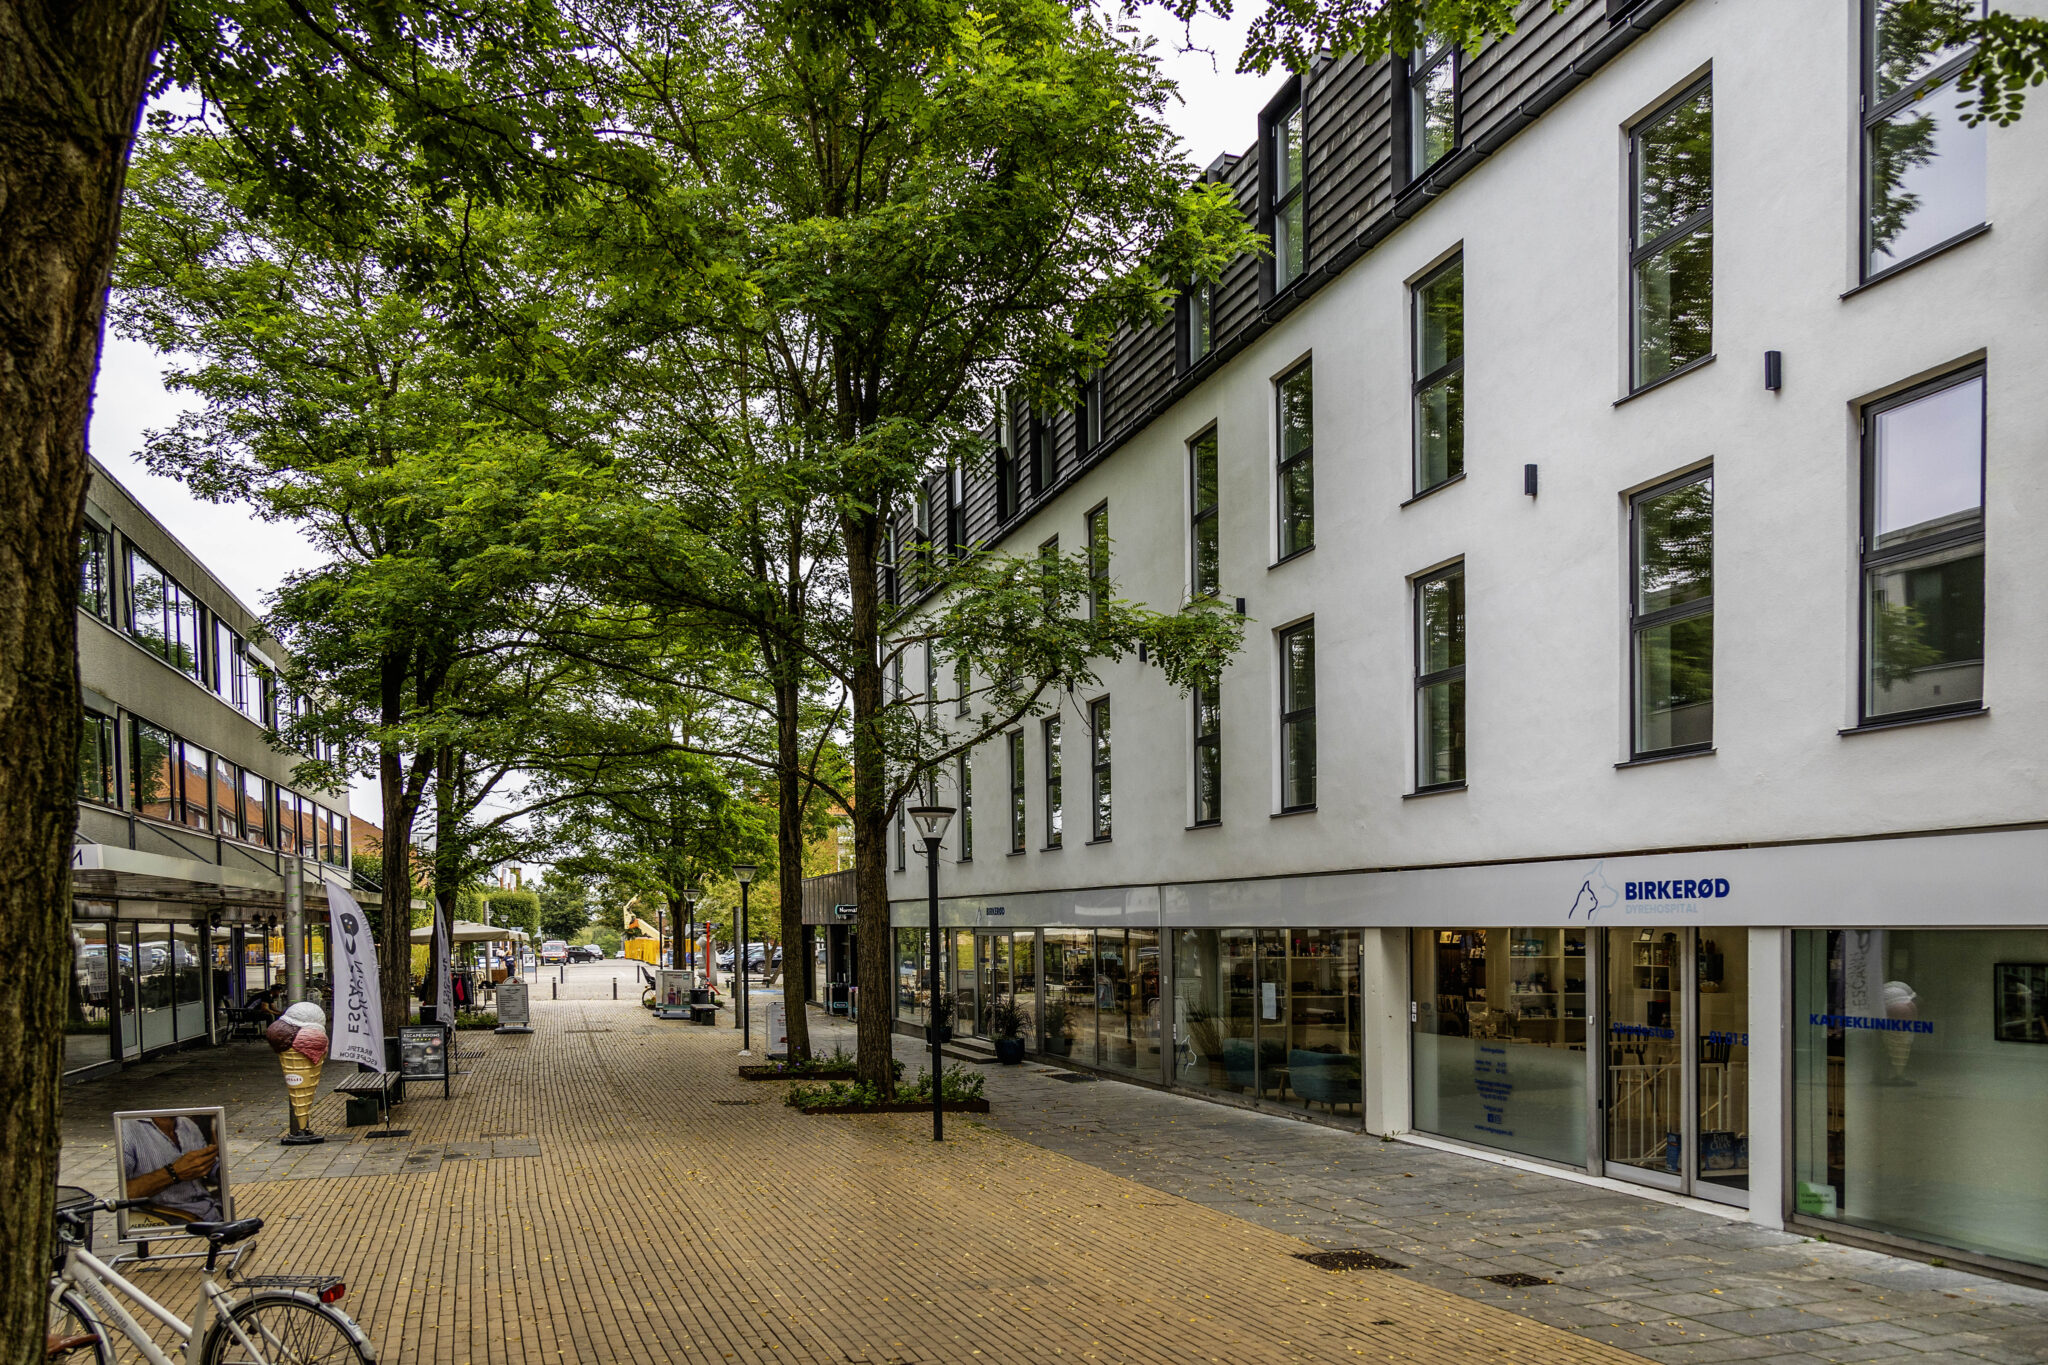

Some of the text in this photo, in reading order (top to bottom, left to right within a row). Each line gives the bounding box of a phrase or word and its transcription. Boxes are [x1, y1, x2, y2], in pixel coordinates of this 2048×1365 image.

[1625, 878, 1730, 901] BIRKERØD
[1625, 903, 1698, 914] DYREHOSPITAL
[1613, 1022, 1675, 1039] Skadestue
[1809, 1013, 1934, 1034] KATTEKLINIKKEN
